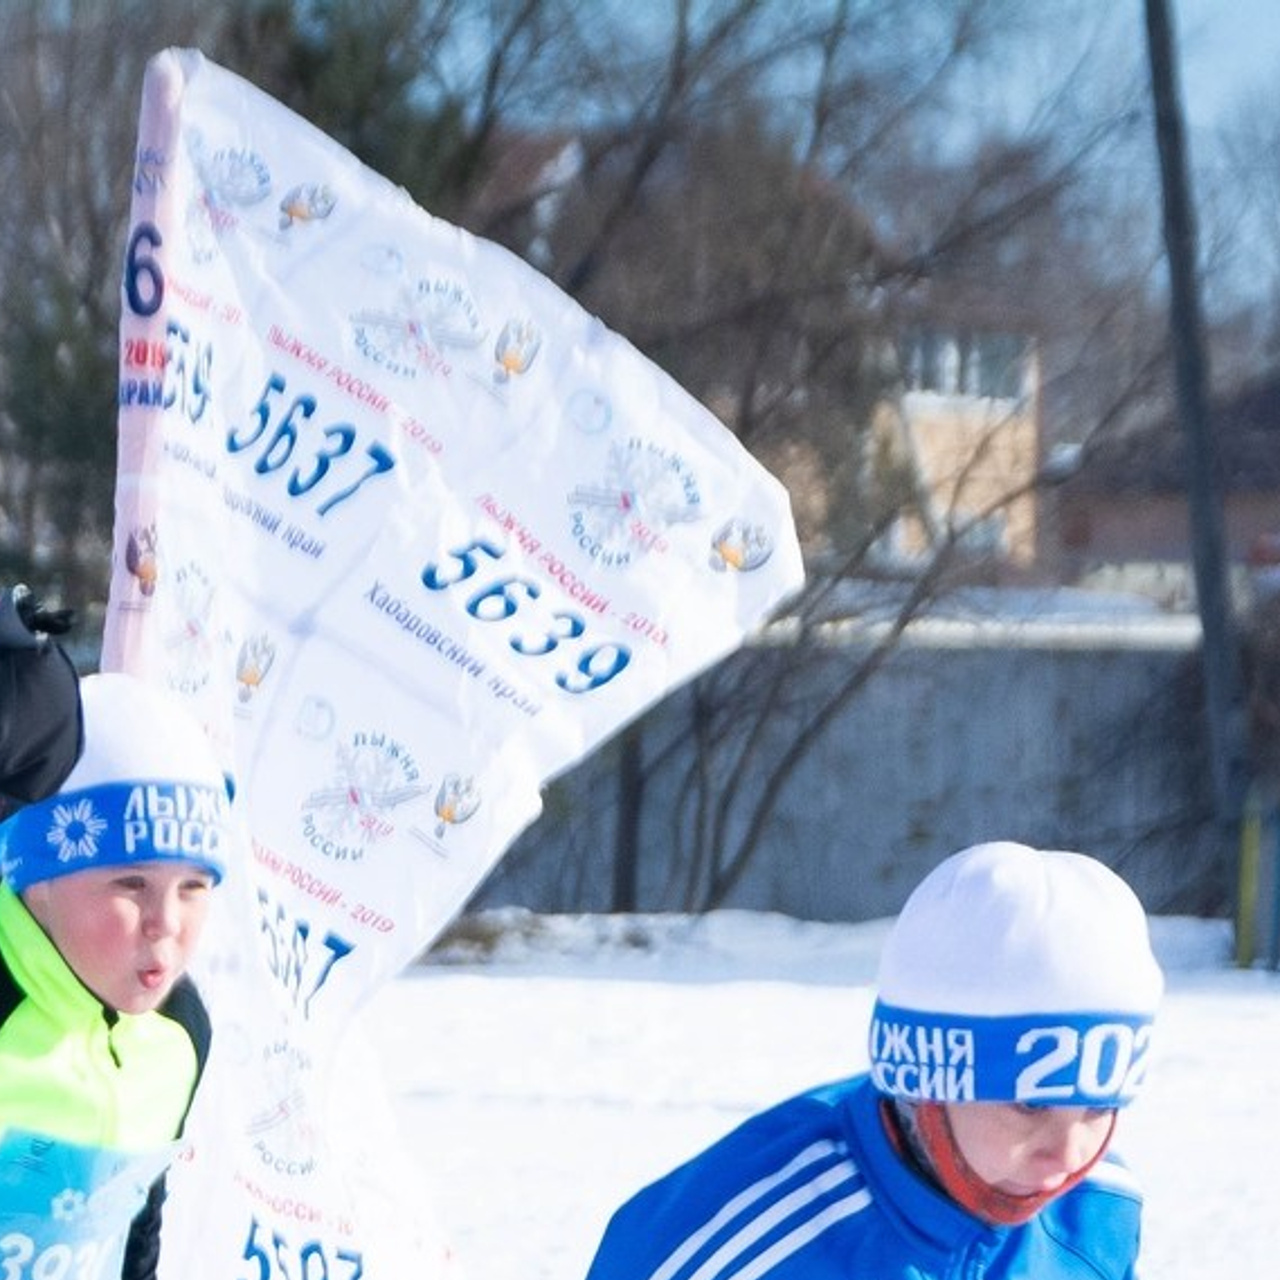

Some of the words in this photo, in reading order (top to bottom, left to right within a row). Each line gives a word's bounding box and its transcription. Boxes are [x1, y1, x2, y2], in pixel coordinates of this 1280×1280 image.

[226, 370, 395, 517] 5637
[422, 538, 632, 695] 5639
[538, 552, 612, 614] РОССИИ
[362, 578, 486, 682] Хабаровский
[354, 730, 420, 783] ЛЫЖНЯ
[302, 813, 364, 860] РОССИИ
[283, 861, 342, 906] РОССИИ
[350, 902, 395, 933] 2019
